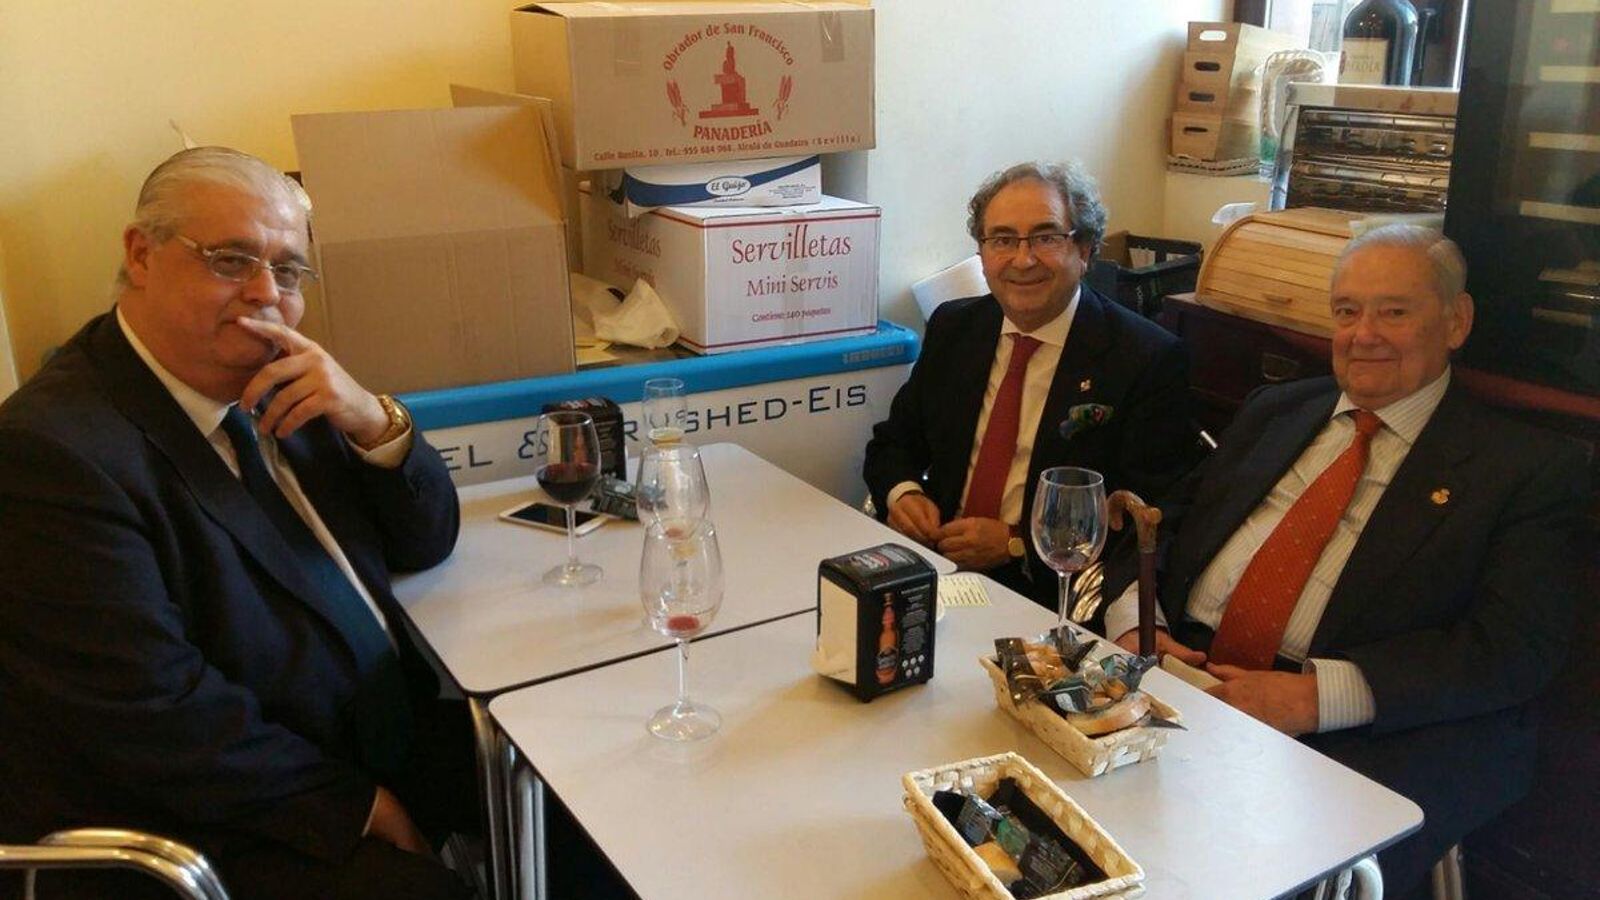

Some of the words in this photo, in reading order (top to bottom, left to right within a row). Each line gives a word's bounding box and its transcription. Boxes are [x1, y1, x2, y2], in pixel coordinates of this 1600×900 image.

[663, 30, 703, 71] Obrador
[706, 24, 720, 37] de
[723, 23, 744, 34] San
[748, 24, 794, 66] Francisco
[693, 120, 773, 140] PANADERÍA
[762, 140, 772, 149] de
[732, 224, 851, 264] Servilletas
[746, 274, 786, 296] Mini
[790, 270, 838, 293] Servis
